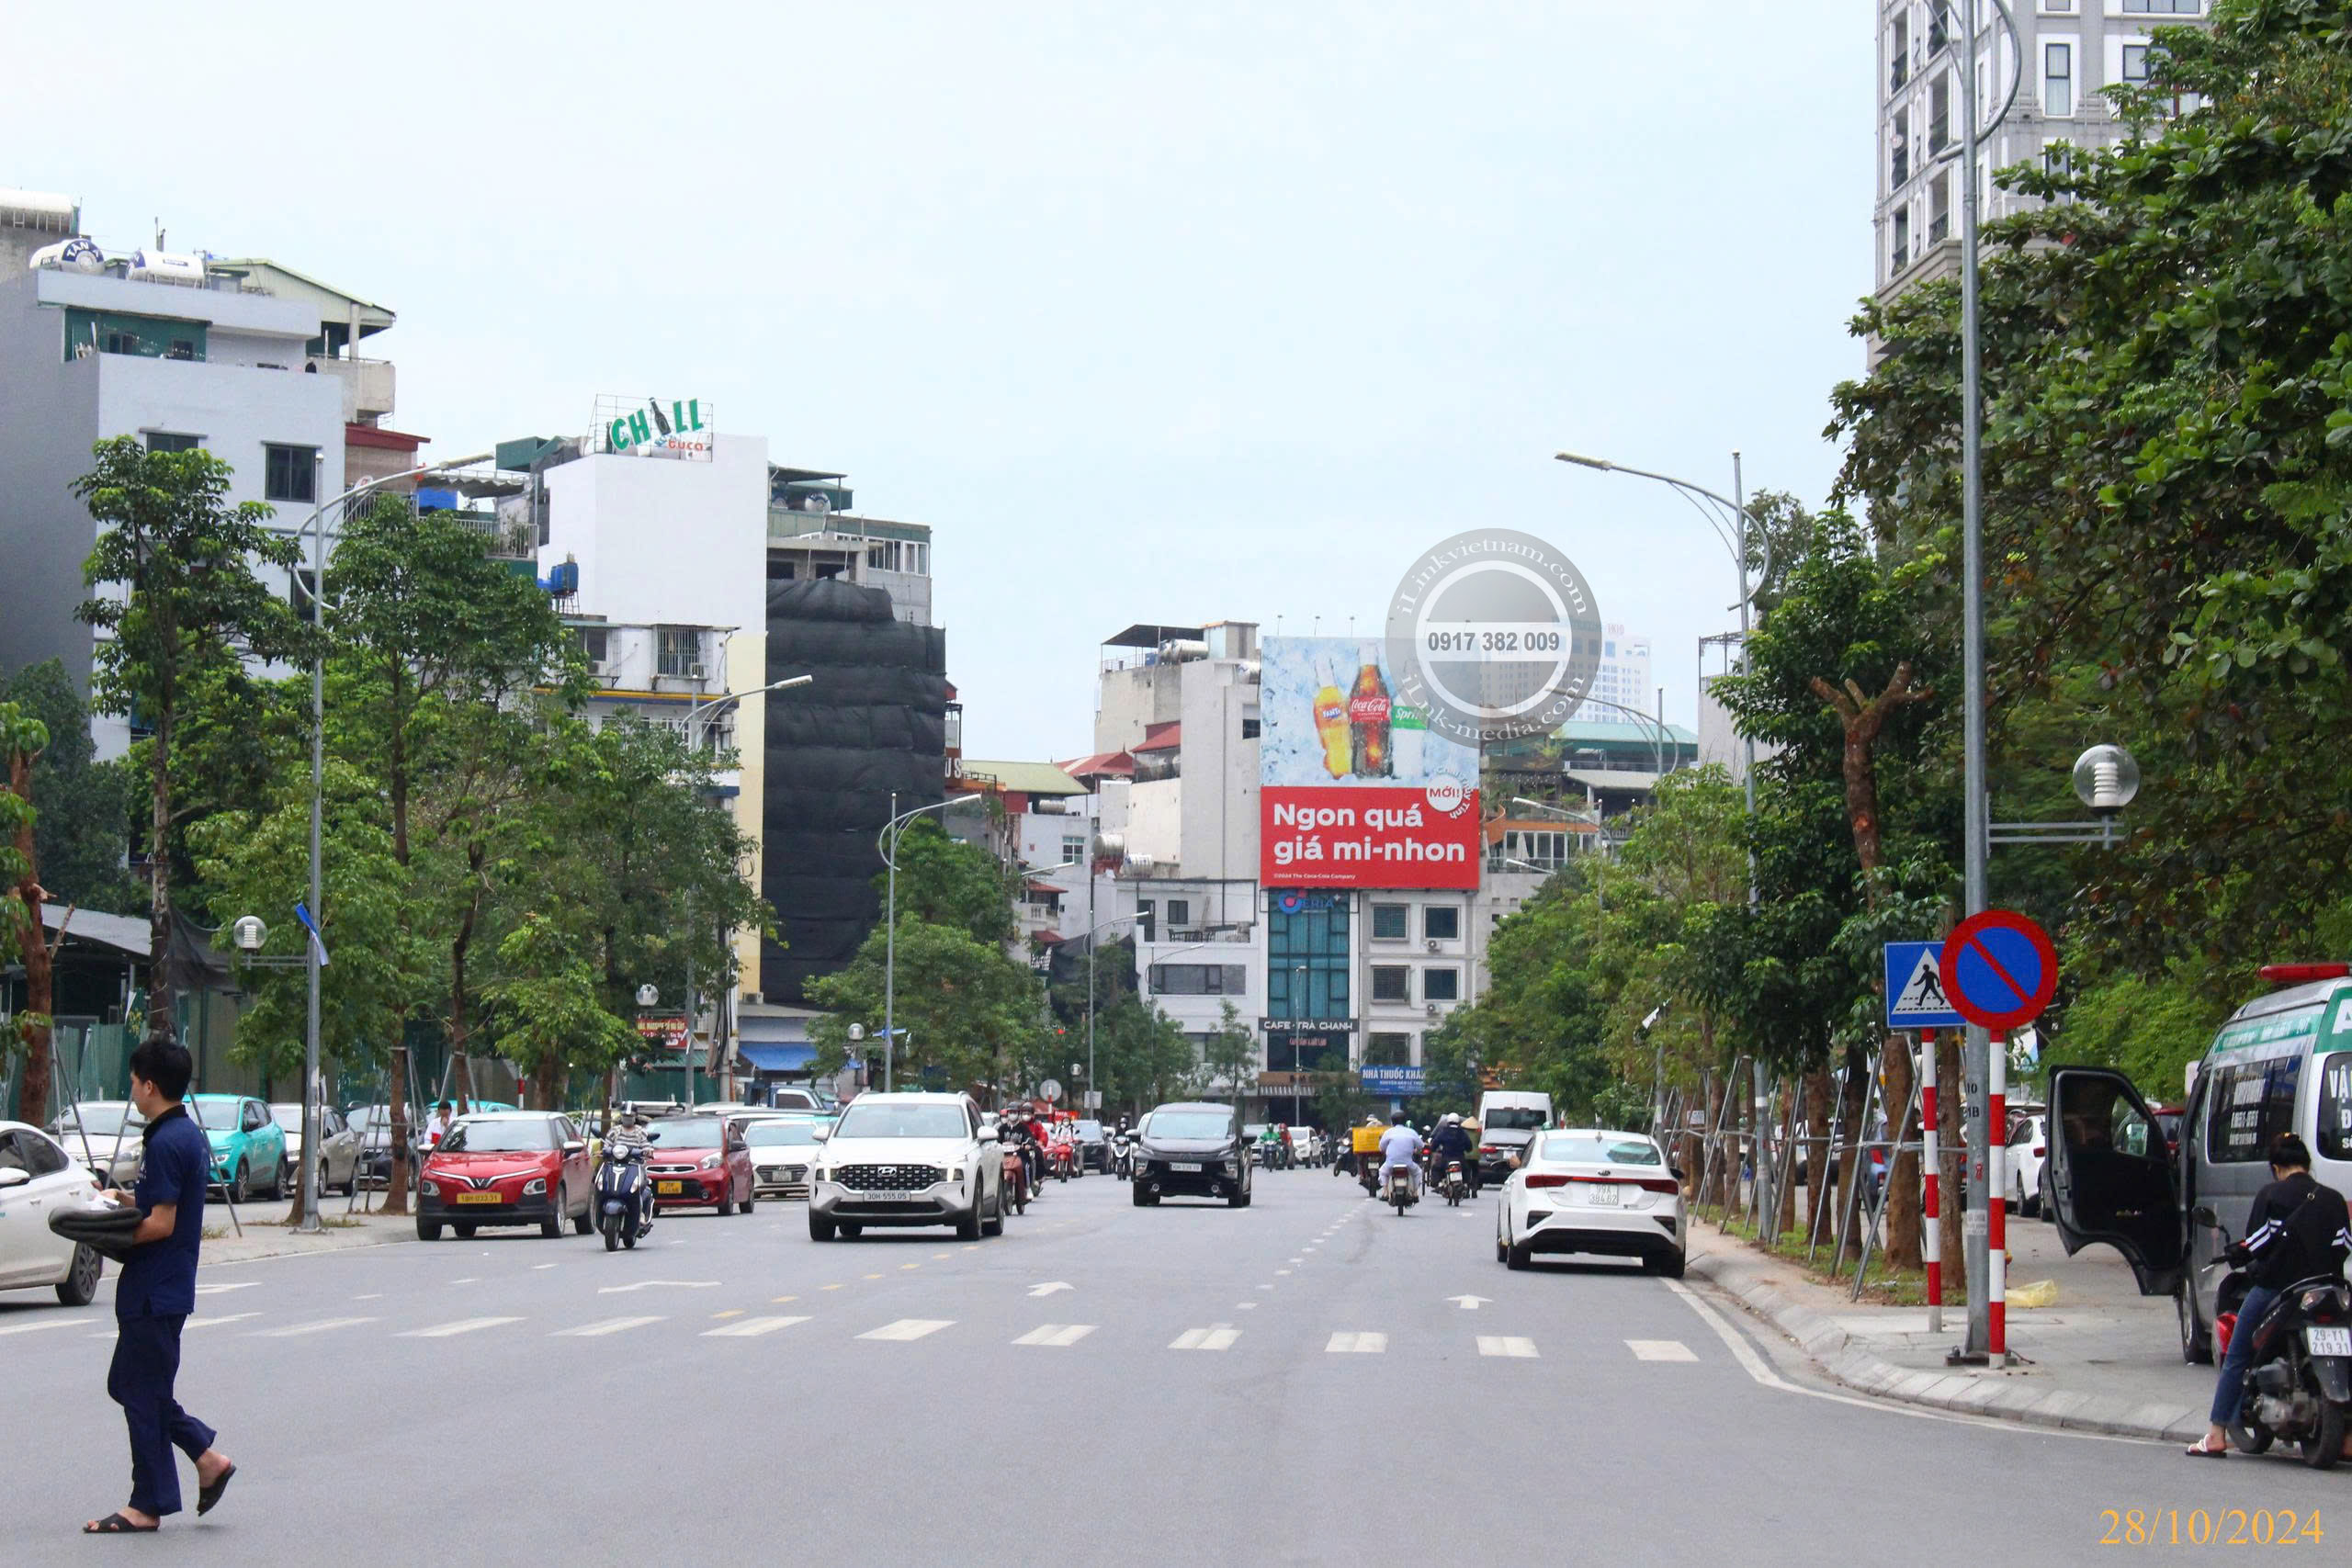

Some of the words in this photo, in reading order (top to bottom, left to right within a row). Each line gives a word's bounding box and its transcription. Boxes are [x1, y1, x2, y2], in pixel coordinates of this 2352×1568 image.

[1273, 803, 1355, 831] Ngon
[1363, 802, 1424, 832] quá
[1273, 834, 1324, 865] giá
[1332, 835, 1465, 863] mi-nhon
[1264, 1021, 1291, 1030] CAFE
[1318, 1021, 1353, 1030] CHANH
[1379, 1066, 1405, 1079] THUỐC
[2329, 1065, 2352, 1104] VẬ
